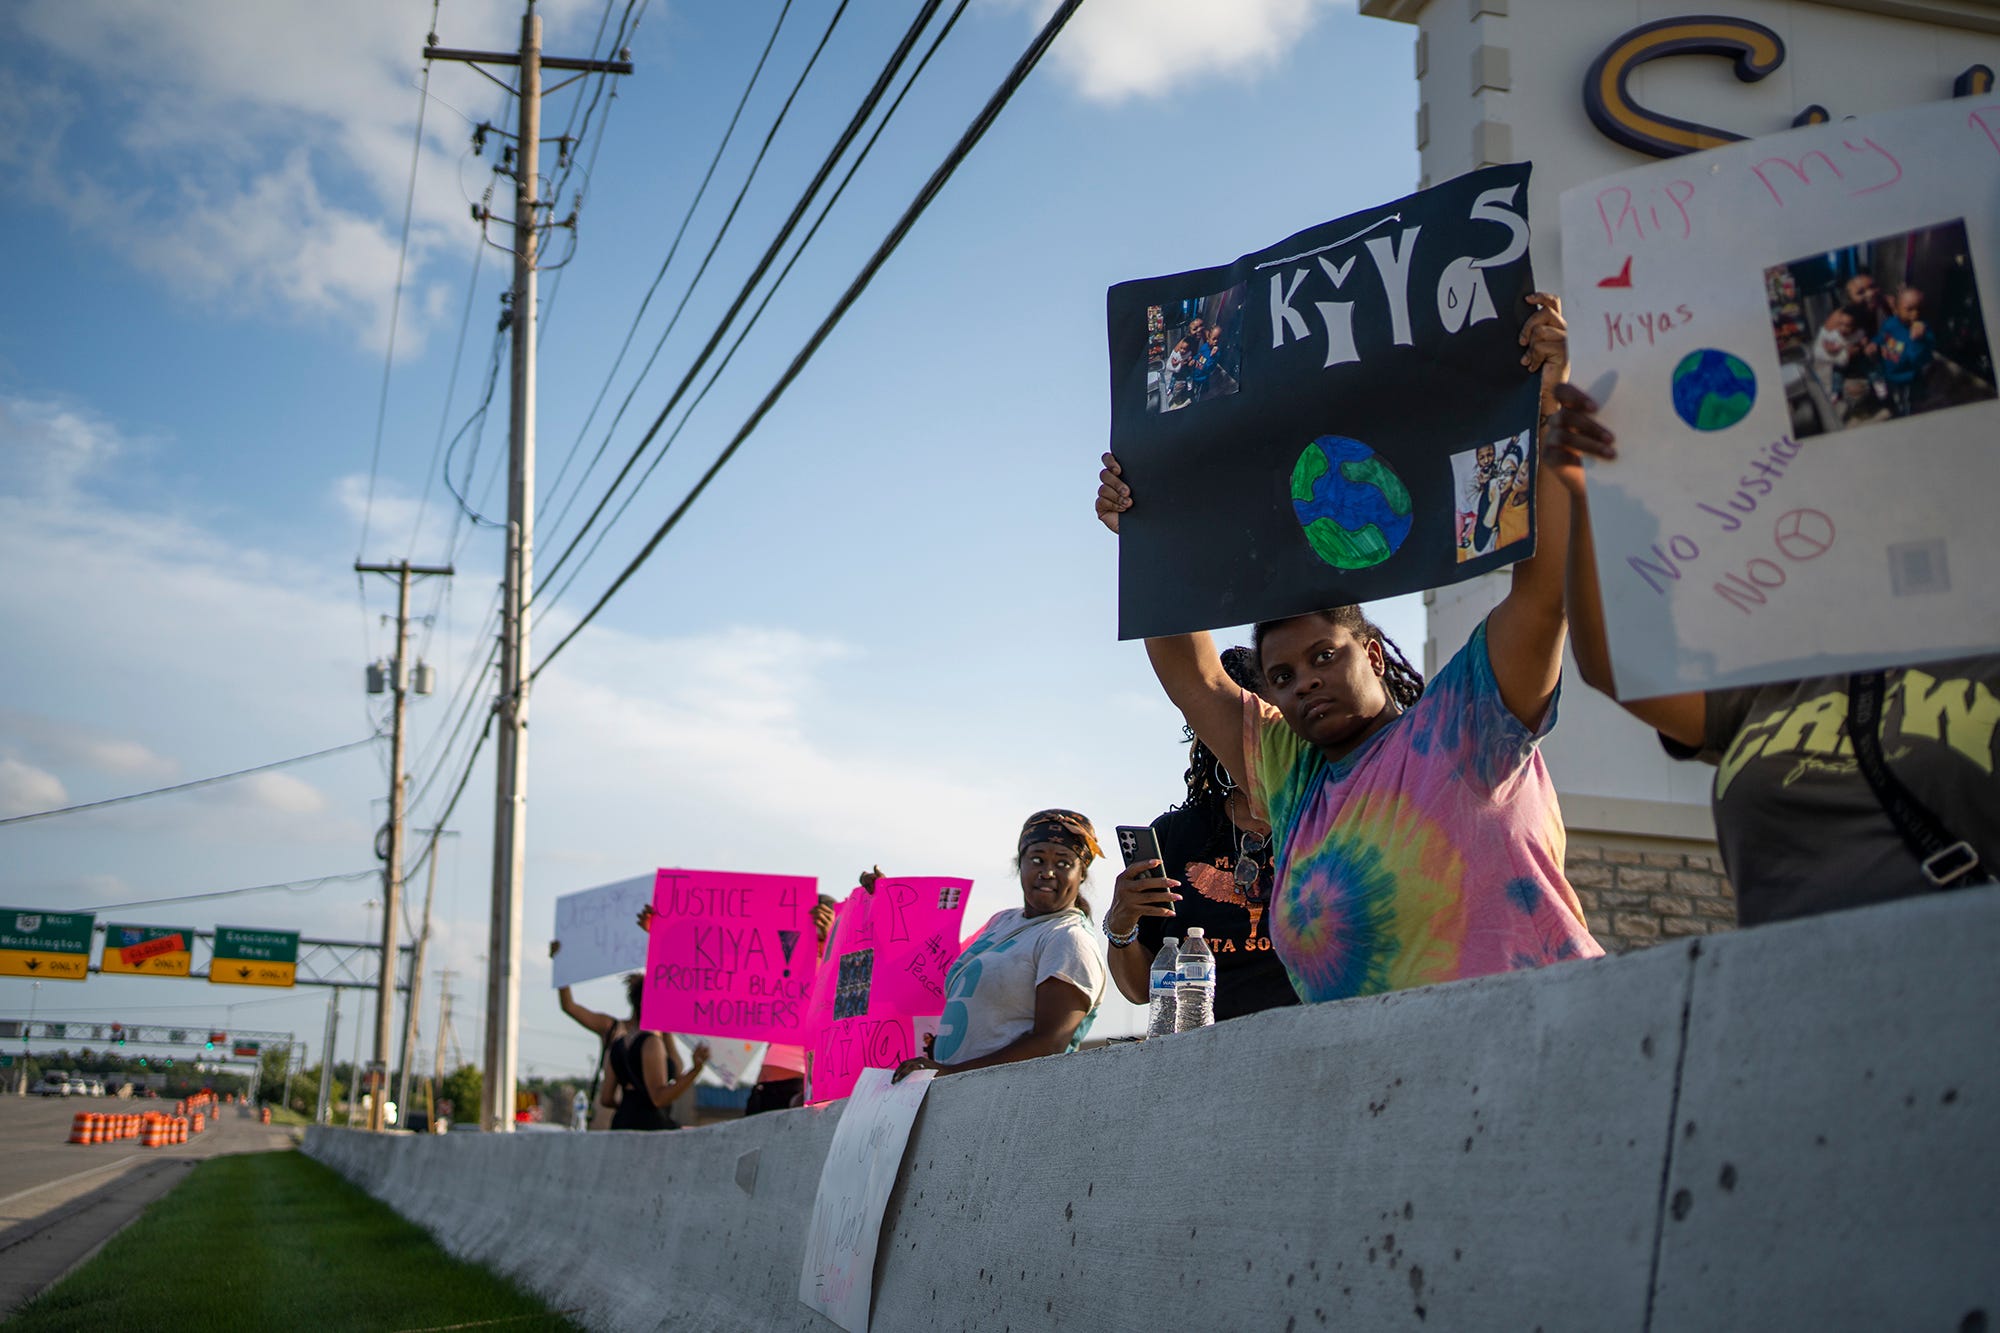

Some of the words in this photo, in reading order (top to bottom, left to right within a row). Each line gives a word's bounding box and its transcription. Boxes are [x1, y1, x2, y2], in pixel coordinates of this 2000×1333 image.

[653, 874, 754, 919] JUSTICE
[778, 887, 800, 928] 4
[1, 934, 82, 951] Worthington
[50, 960, 80, 971] ONLY
[154, 959, 184, 970] ONLY
[904, 953, 944, 997] Peace
[654, 963, 735, 992] PROTECT
[750, 974, 811, 1000] BLACK
[693, 999, 799, 1028] MOTHERS
